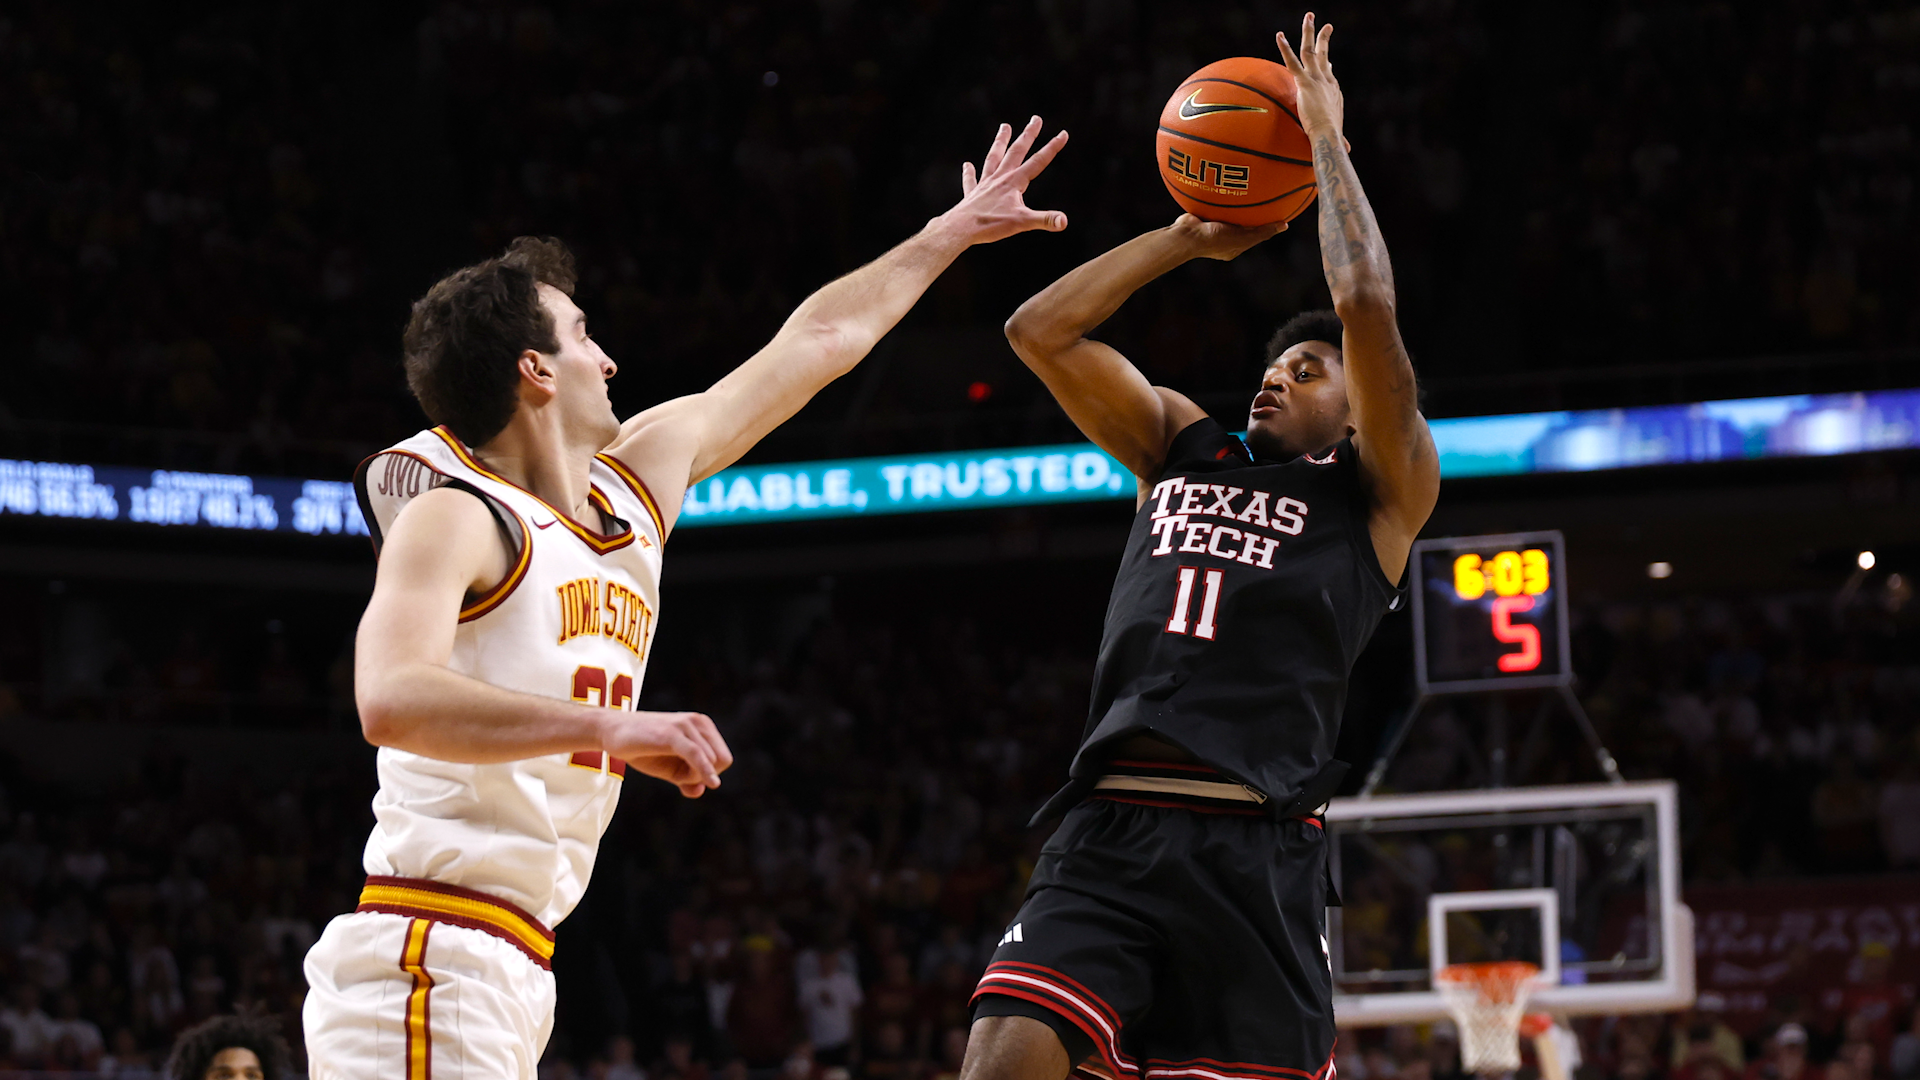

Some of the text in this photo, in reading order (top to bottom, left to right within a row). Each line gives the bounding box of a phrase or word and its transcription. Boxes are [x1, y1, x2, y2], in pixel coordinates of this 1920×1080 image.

[1169, 171, 1248, 196] HAMPIONSHIP
[882, 451, 1122, 502] TRUSTED,
[1150, 476, 1309, 536] TEXAS
[1151, 514, 1280, 570] TECH
[1164, 564, 1225, 642] 11
[1453, 548, 1550, 601] 6:03
[556, 576, 653, 665] IOWA STATE
[1491, 594, 1542, 672] 5
